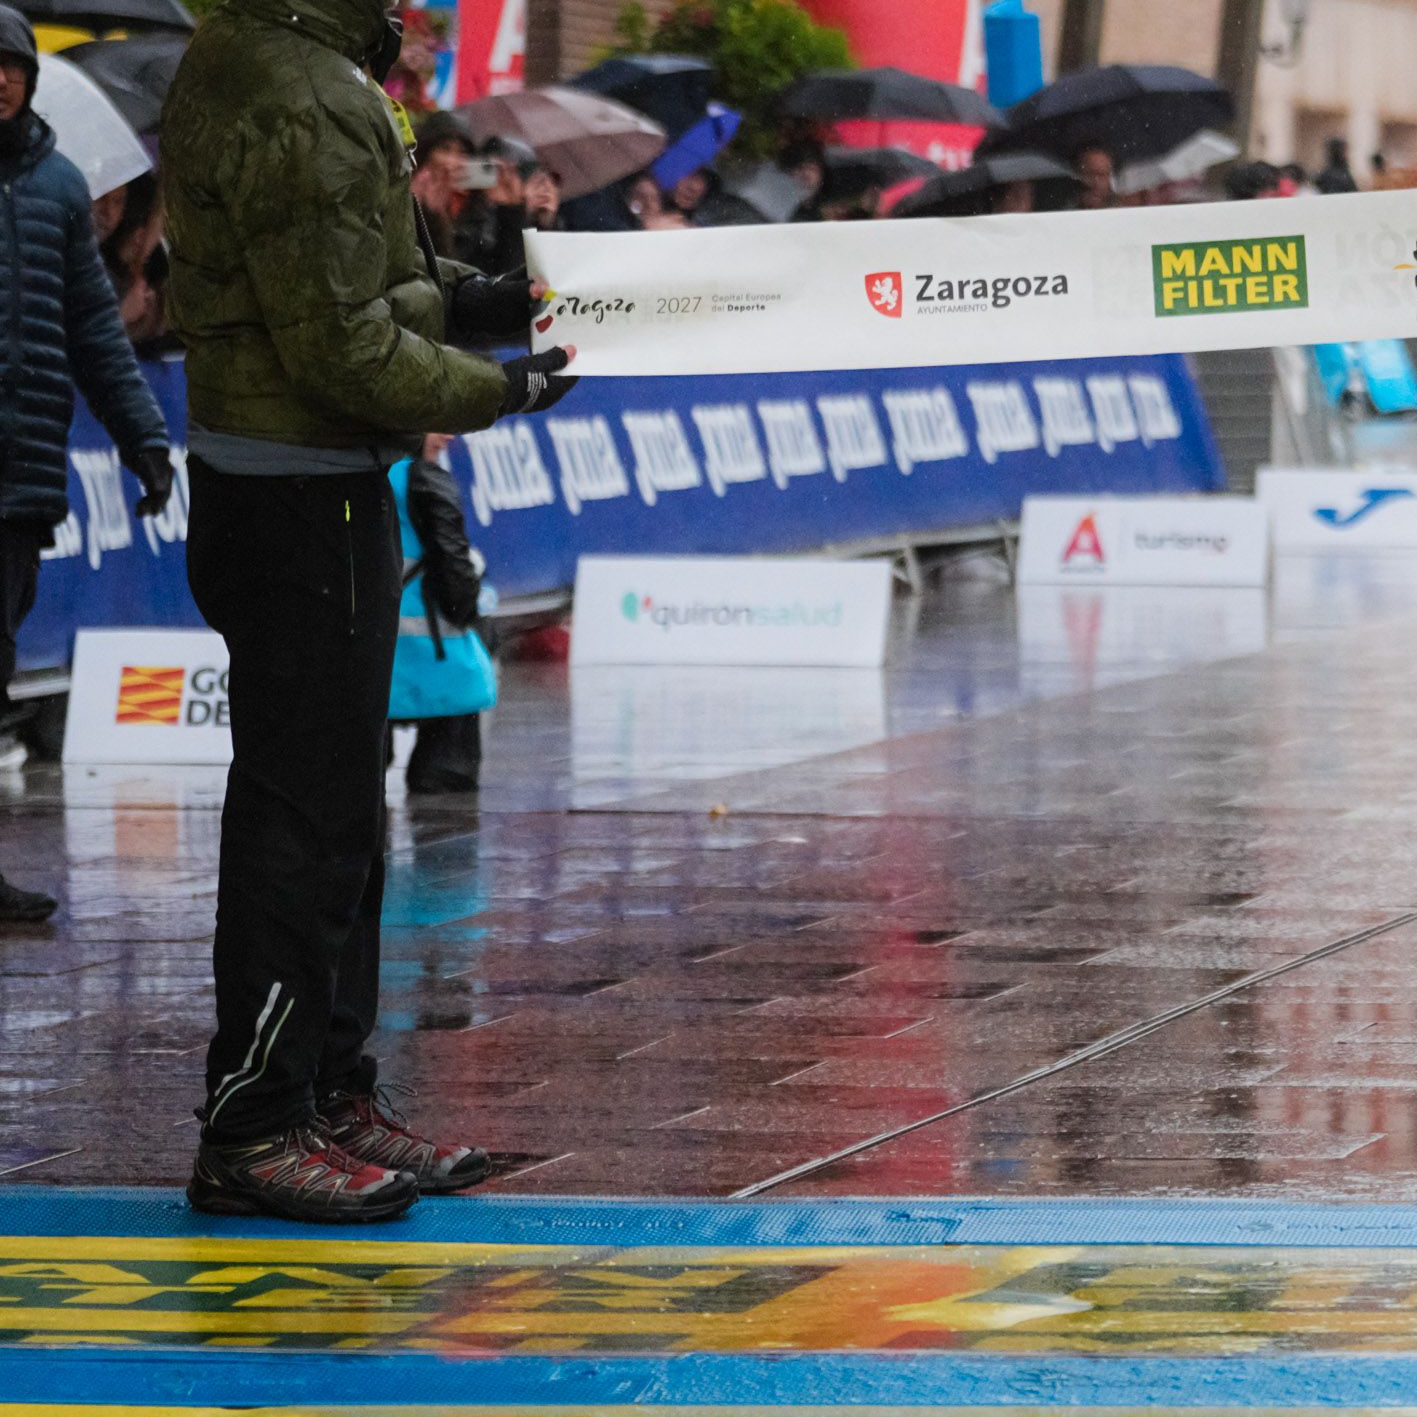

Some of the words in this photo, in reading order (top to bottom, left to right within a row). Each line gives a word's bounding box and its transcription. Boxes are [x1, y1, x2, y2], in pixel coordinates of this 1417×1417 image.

[1160, 242, 1298, 278] MANN
[915, 270, 1069, 308] Zaragoza
[1162, 274, 1302, 309] FILTER
[656, 297, 702, 314] 2027
[727, 303, 766, 313] Deporte
[917, 303, 987, 315] AYUNTAMIENTO
[187, 700, 230, 726] DE
